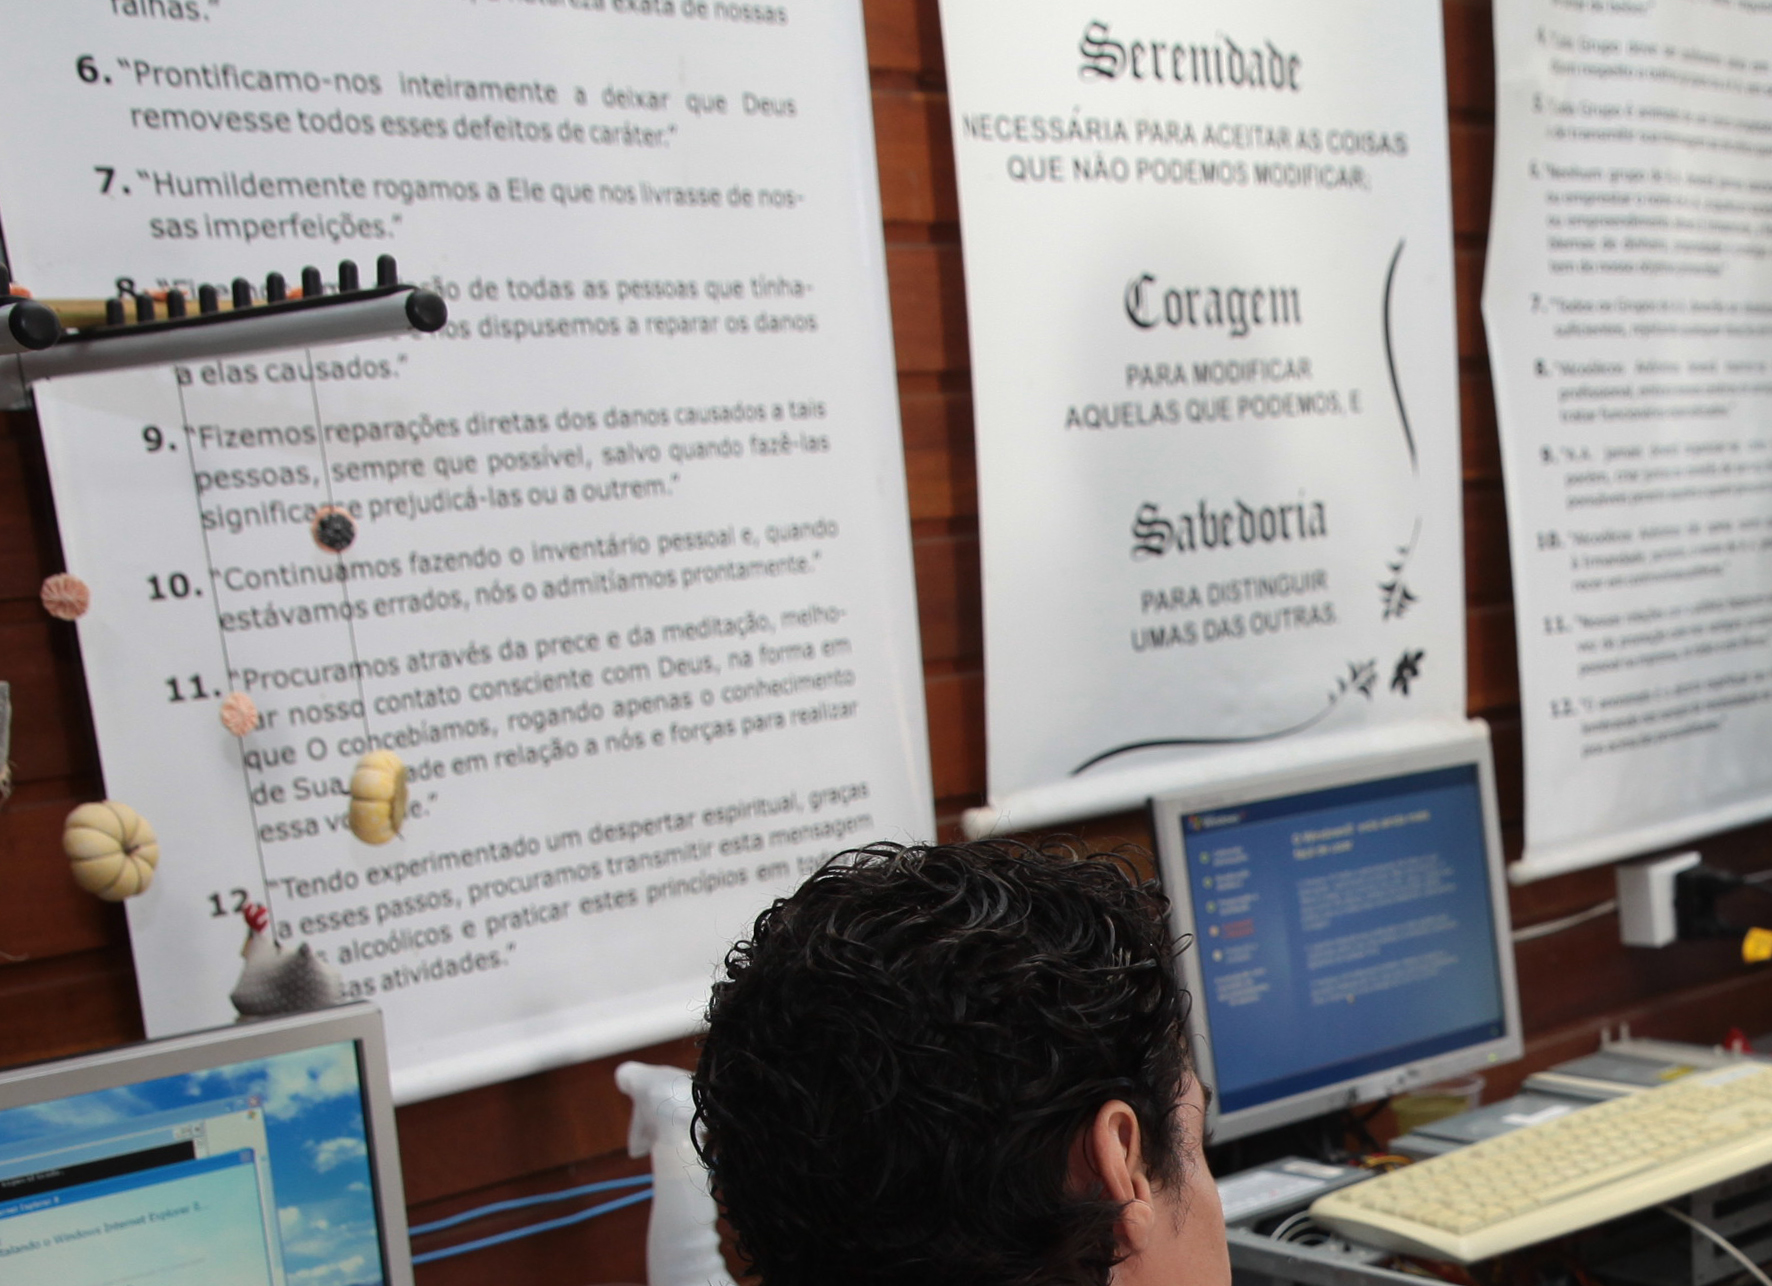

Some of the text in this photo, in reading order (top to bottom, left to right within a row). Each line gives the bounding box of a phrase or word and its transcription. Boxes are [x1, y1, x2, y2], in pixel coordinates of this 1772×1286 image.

[714, 2, 788, 25] nossas
[1079, 17, 1302, 94] Serenidade
[76, 55, 111, 84] 6.
[400, 75, 558, 104] inteiramente
[575, 87, 587, 106] a
[602, 86, 669, 111] deixar
[686, 94, 727, 115] que
[742, 92, 797, 117] Deus
[130, 108, 585, 143] removesse todos esses defeitos de
[964, 105, 1408, 156] NECESSÁRIA PARA ACEITAR AS COISAS
[94, 167, 130, 194] 7.
[373, 179, 480, 205] rogamos
[487, 182, 501, 201] a
[507, 178, 544, 202] Ele
[550, 183, 594, 206] que
[599, 184, 637, 205] nos
[640, 183, 722, 207] livrasse
[726, 186, 753, 208] de
[1007, 155, 1063, 182] QUE
[1073, 152, 1129, 183] NÃO
[1136, 158, 1249, 185] PODEMOS
[150, 218, 199, 239] sas
[469, 278, 498, 301] de
[506, 277, 575, 300] todas
[583, 281, 609, 299] as
[616, 280, 699, 301] pessoas
[704, 280, 744, 301] que
[1124, 271, 1302, 339] Coragem
[478, 315, 621, 342] dispusemos
[176, 364, 258, 385] a elas
[1126, 357, 1311, 387] PARA MODIFICAR
[142, 425, 176, 452] 9.
[325, 414, 460, 443] reparações
[466, 413, 550, 436] diretas
[555, 410, 598, 431] dos
[603, 408, 670, 429] danos
[674, 403, 767, 425] causados
[1065, 400, 1181, 430] AQUELAS
[1185, 396, 1231, 423] QUE
[1349, 389, 1361, 413] E
[195, 438, 743, 491] pessoas, sempre que possível, salvo quando
[368, 485, 577, 522] prejudicá-las ou a
[1129, 490, 1328, 562] Sabedoria
[148, 573, 202, 600] 10.
[409, 547, 501, 574] fazendo
[508, 547, 525, 566] o
[532, 534, 650, 562] inventário
[657, 528, 735, 555] pessoal
[219, 569, 677, 633] estávamos errados, nós o admitíamos
[1141, 569, 1328, 612] PARA DISTINGUIR
[1132, 622, 1198, 652] UMAS
[1203, 614, 1246, 643] DAS
[167, 674, 221, 702] 11.
[407, 641, 492, 673] através
[498, 639, 528, 661] da
[535, 633, 599, 660] prece
[607, 632, 620, 649] e
[627, 626, 655, 647] da
[289, 701, 365, 726] nosso
[373, 686, 461, 715] contato
[468, 669, 593, 702] consciente
[601, 663, 650, 686] com
[244, 744, 295, 771] que
[306, 737, 328, 761] O
[507, 701, 604, 734] rogando
[612, 691, 693, 719] apenas
[700, 689, 715, 706] o
[721, 669, 856, 704] conhecimento
[252, 781, 285, 807] de
[293, 776, 343, 802] Sua
[451, 754, 488, 775] em
[494, 737, 579, 767] relação
[585, 738, 599, 755] a
[605, 728, 646, 751] nós
[651, 730, 664, 746] e
[669, 719, 737, 744] forças
[741, 712, 786, 736] para
[260, 817, 319, 843] essa
[365, 837, 540, 886] experimentado
[545, 830, 582, 852] um
[588, 812, 695, 845] despertar
[278, 834, 764, 939] a esses passos, procuramos transmitir esta
[461, 921, 475, 938] e
[485, 901, 571, 939] praticar
[579, 889, 638, 915] estes
[646, 868, 749, 906] princípios
